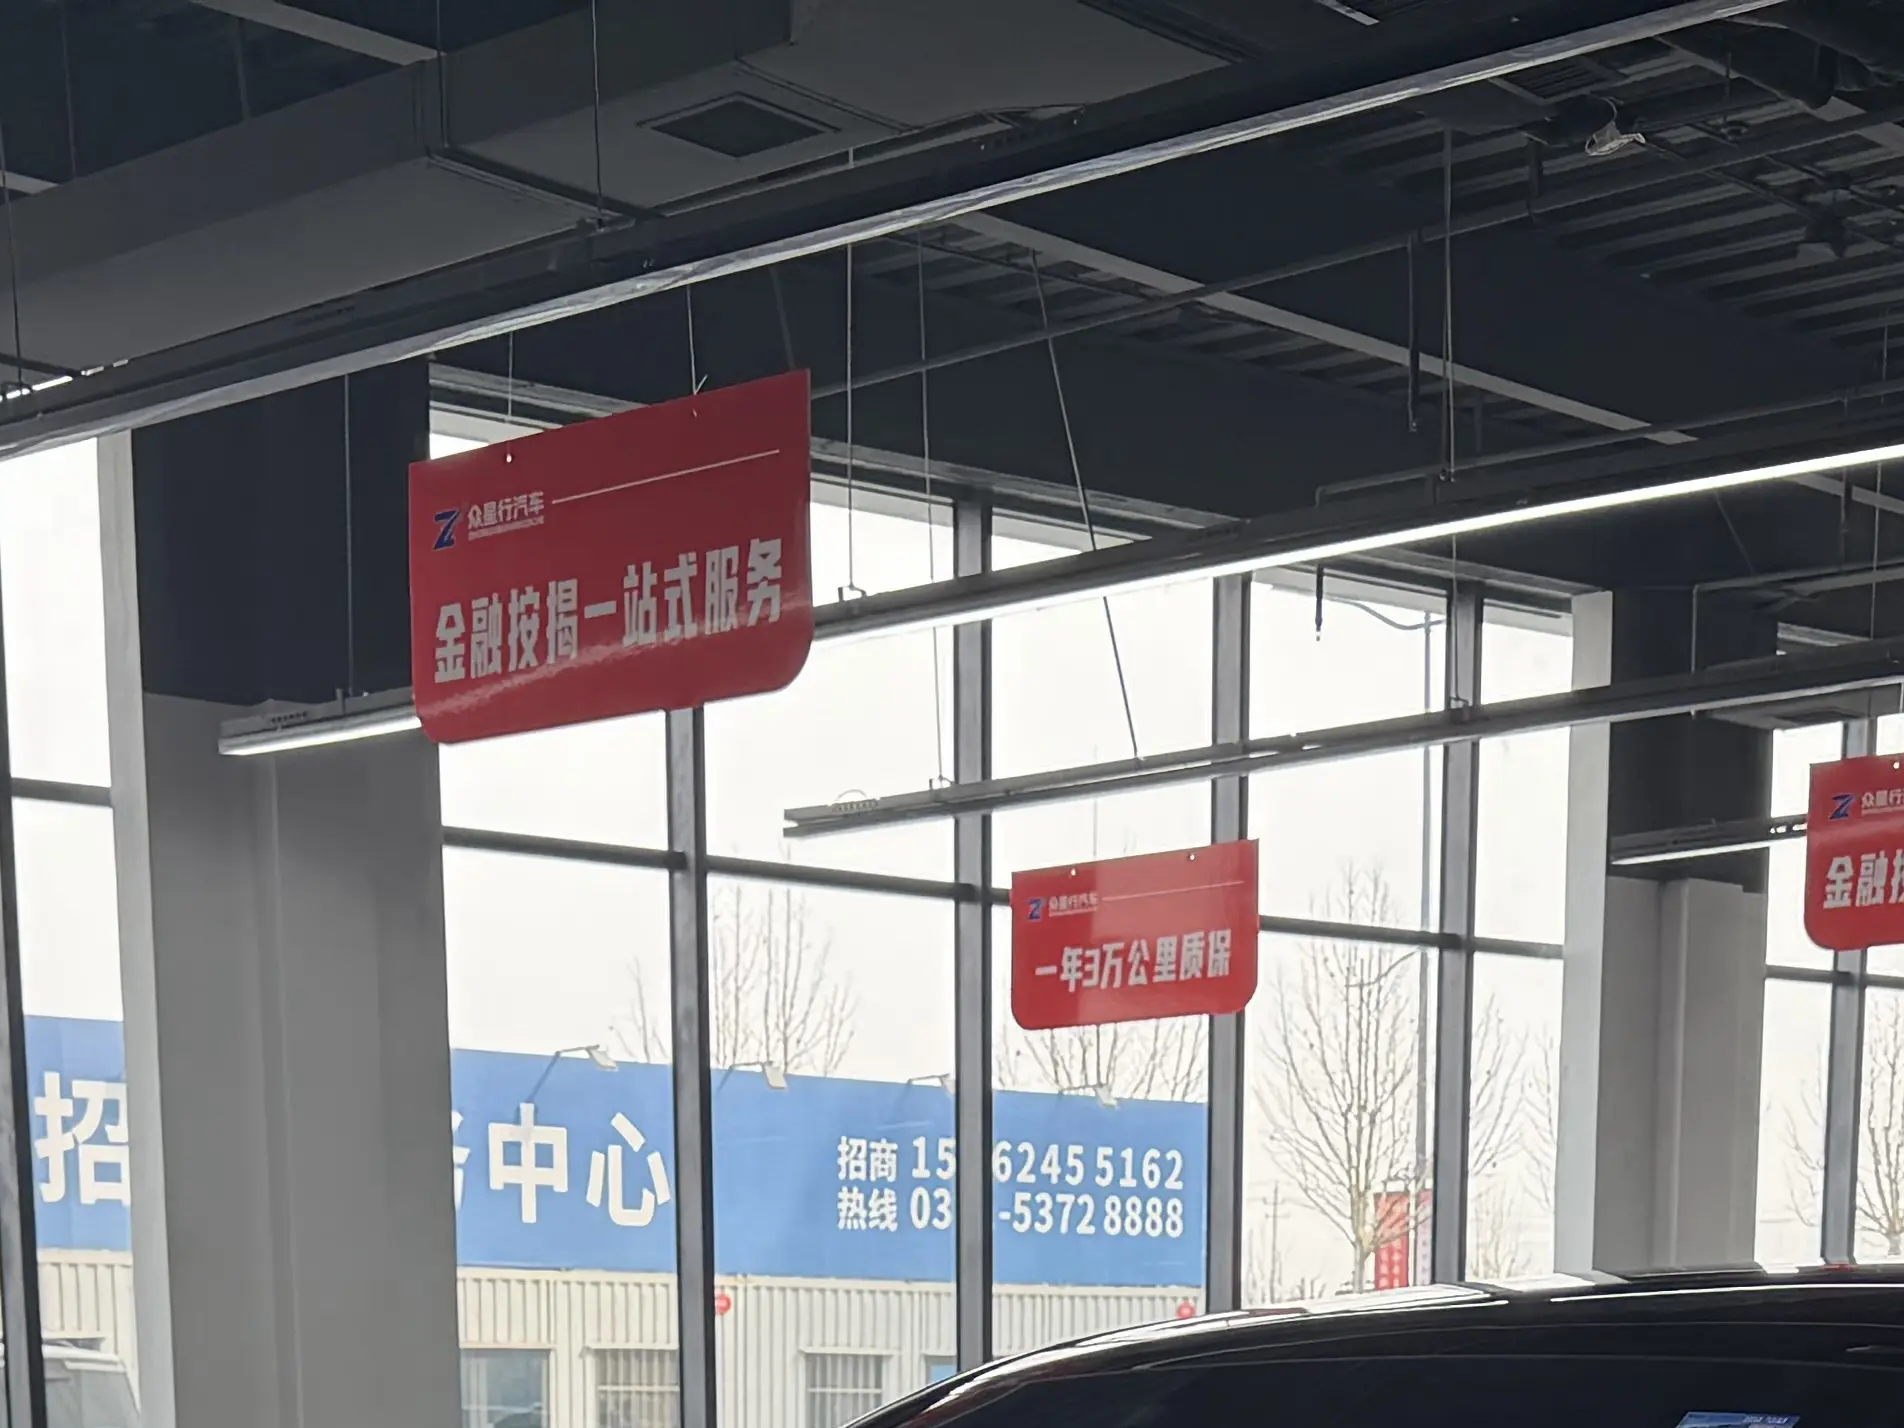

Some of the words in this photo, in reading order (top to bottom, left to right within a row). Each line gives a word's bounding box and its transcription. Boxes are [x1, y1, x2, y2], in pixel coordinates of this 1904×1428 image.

[434, 538, 783, 684] 金融按揭一站式服务
[1035, 928, 1232, 993] 一年3万公里质保
[837, 1136, 898, 1182] 招商
[1095, 1147, 1183, 1190] 5162
[837, 1187, 898, 1232] 热线
[1103, 1195, 1183, 1238] 8888
